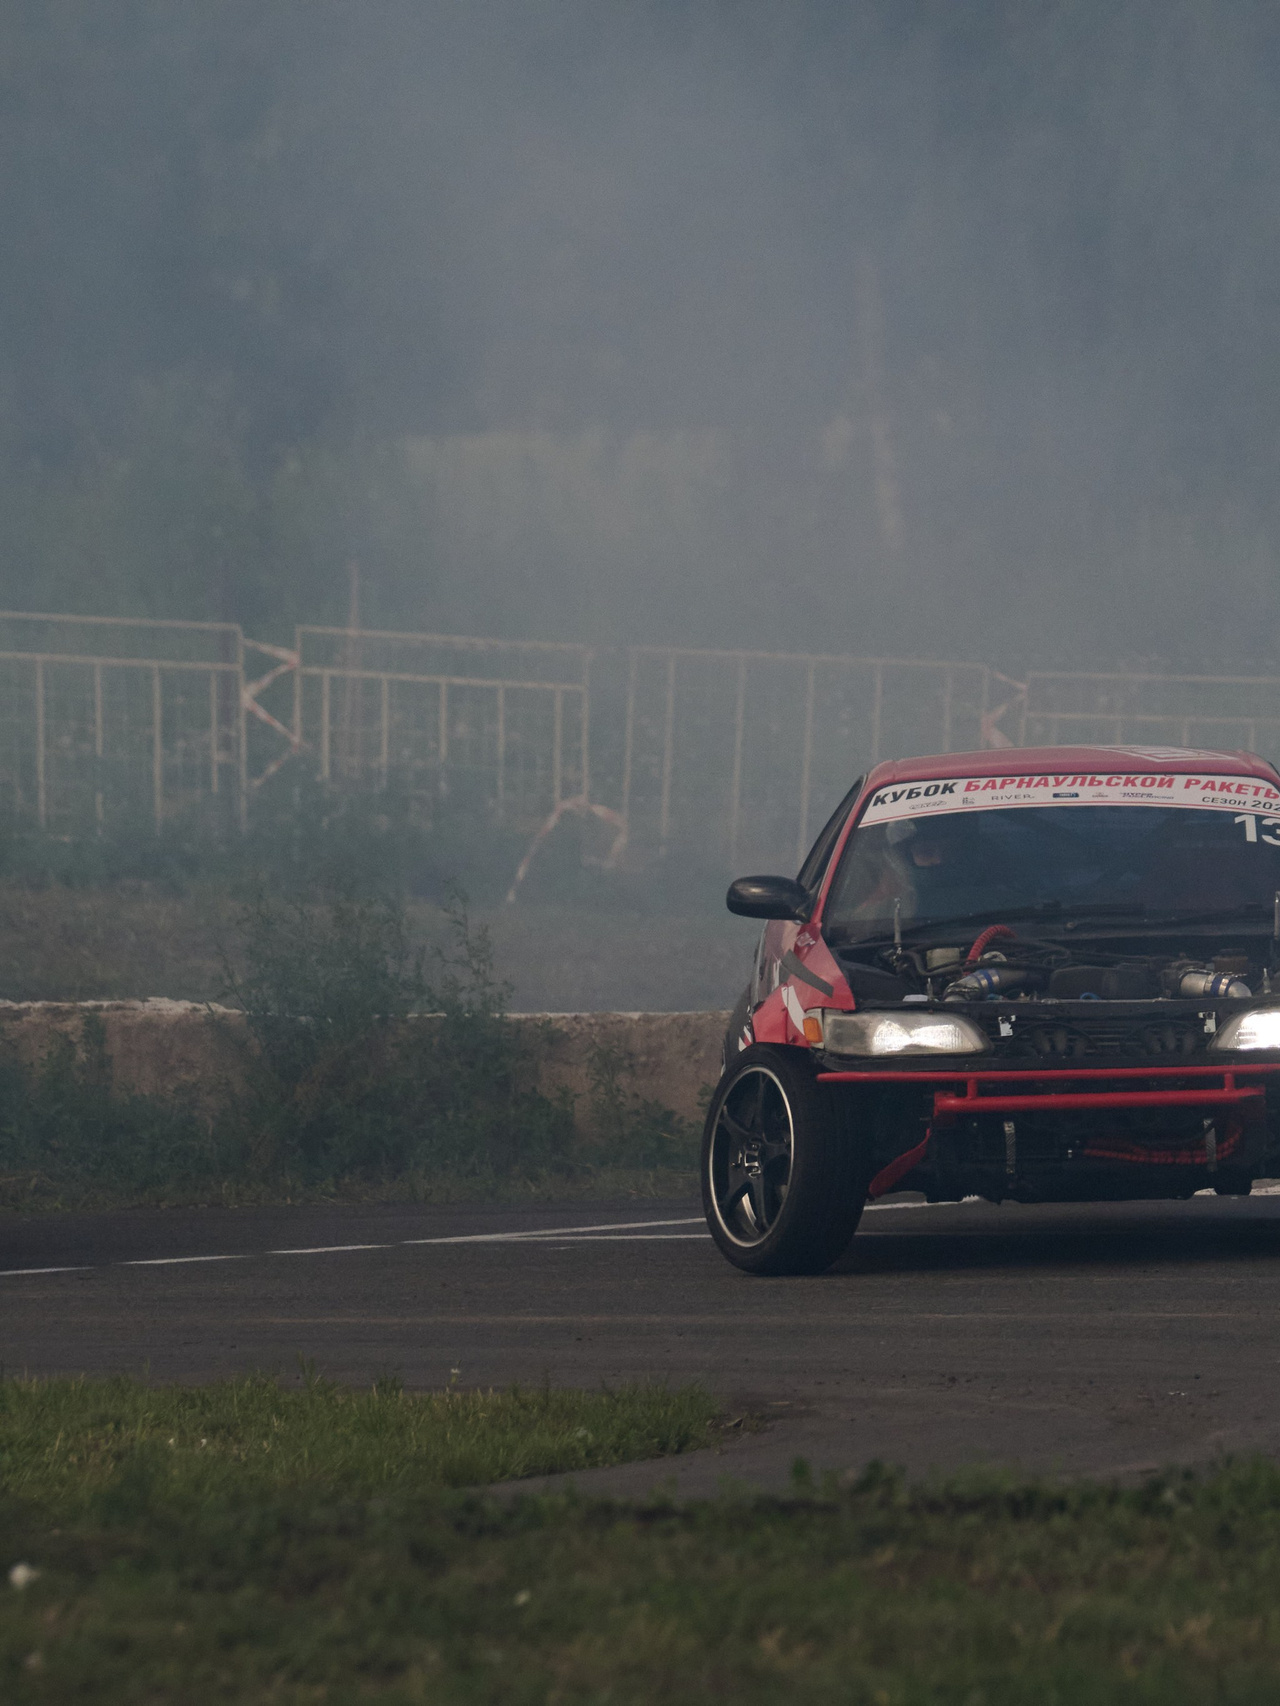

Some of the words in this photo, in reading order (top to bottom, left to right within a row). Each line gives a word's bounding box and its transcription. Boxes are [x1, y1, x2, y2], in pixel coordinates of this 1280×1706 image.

[872, 782, 959, 807] КУБОК
[963, 774, 1176, 792] БАРНАУЛЬСКОЙ
[1201, 796, 1247, 807] СЕЗОН
